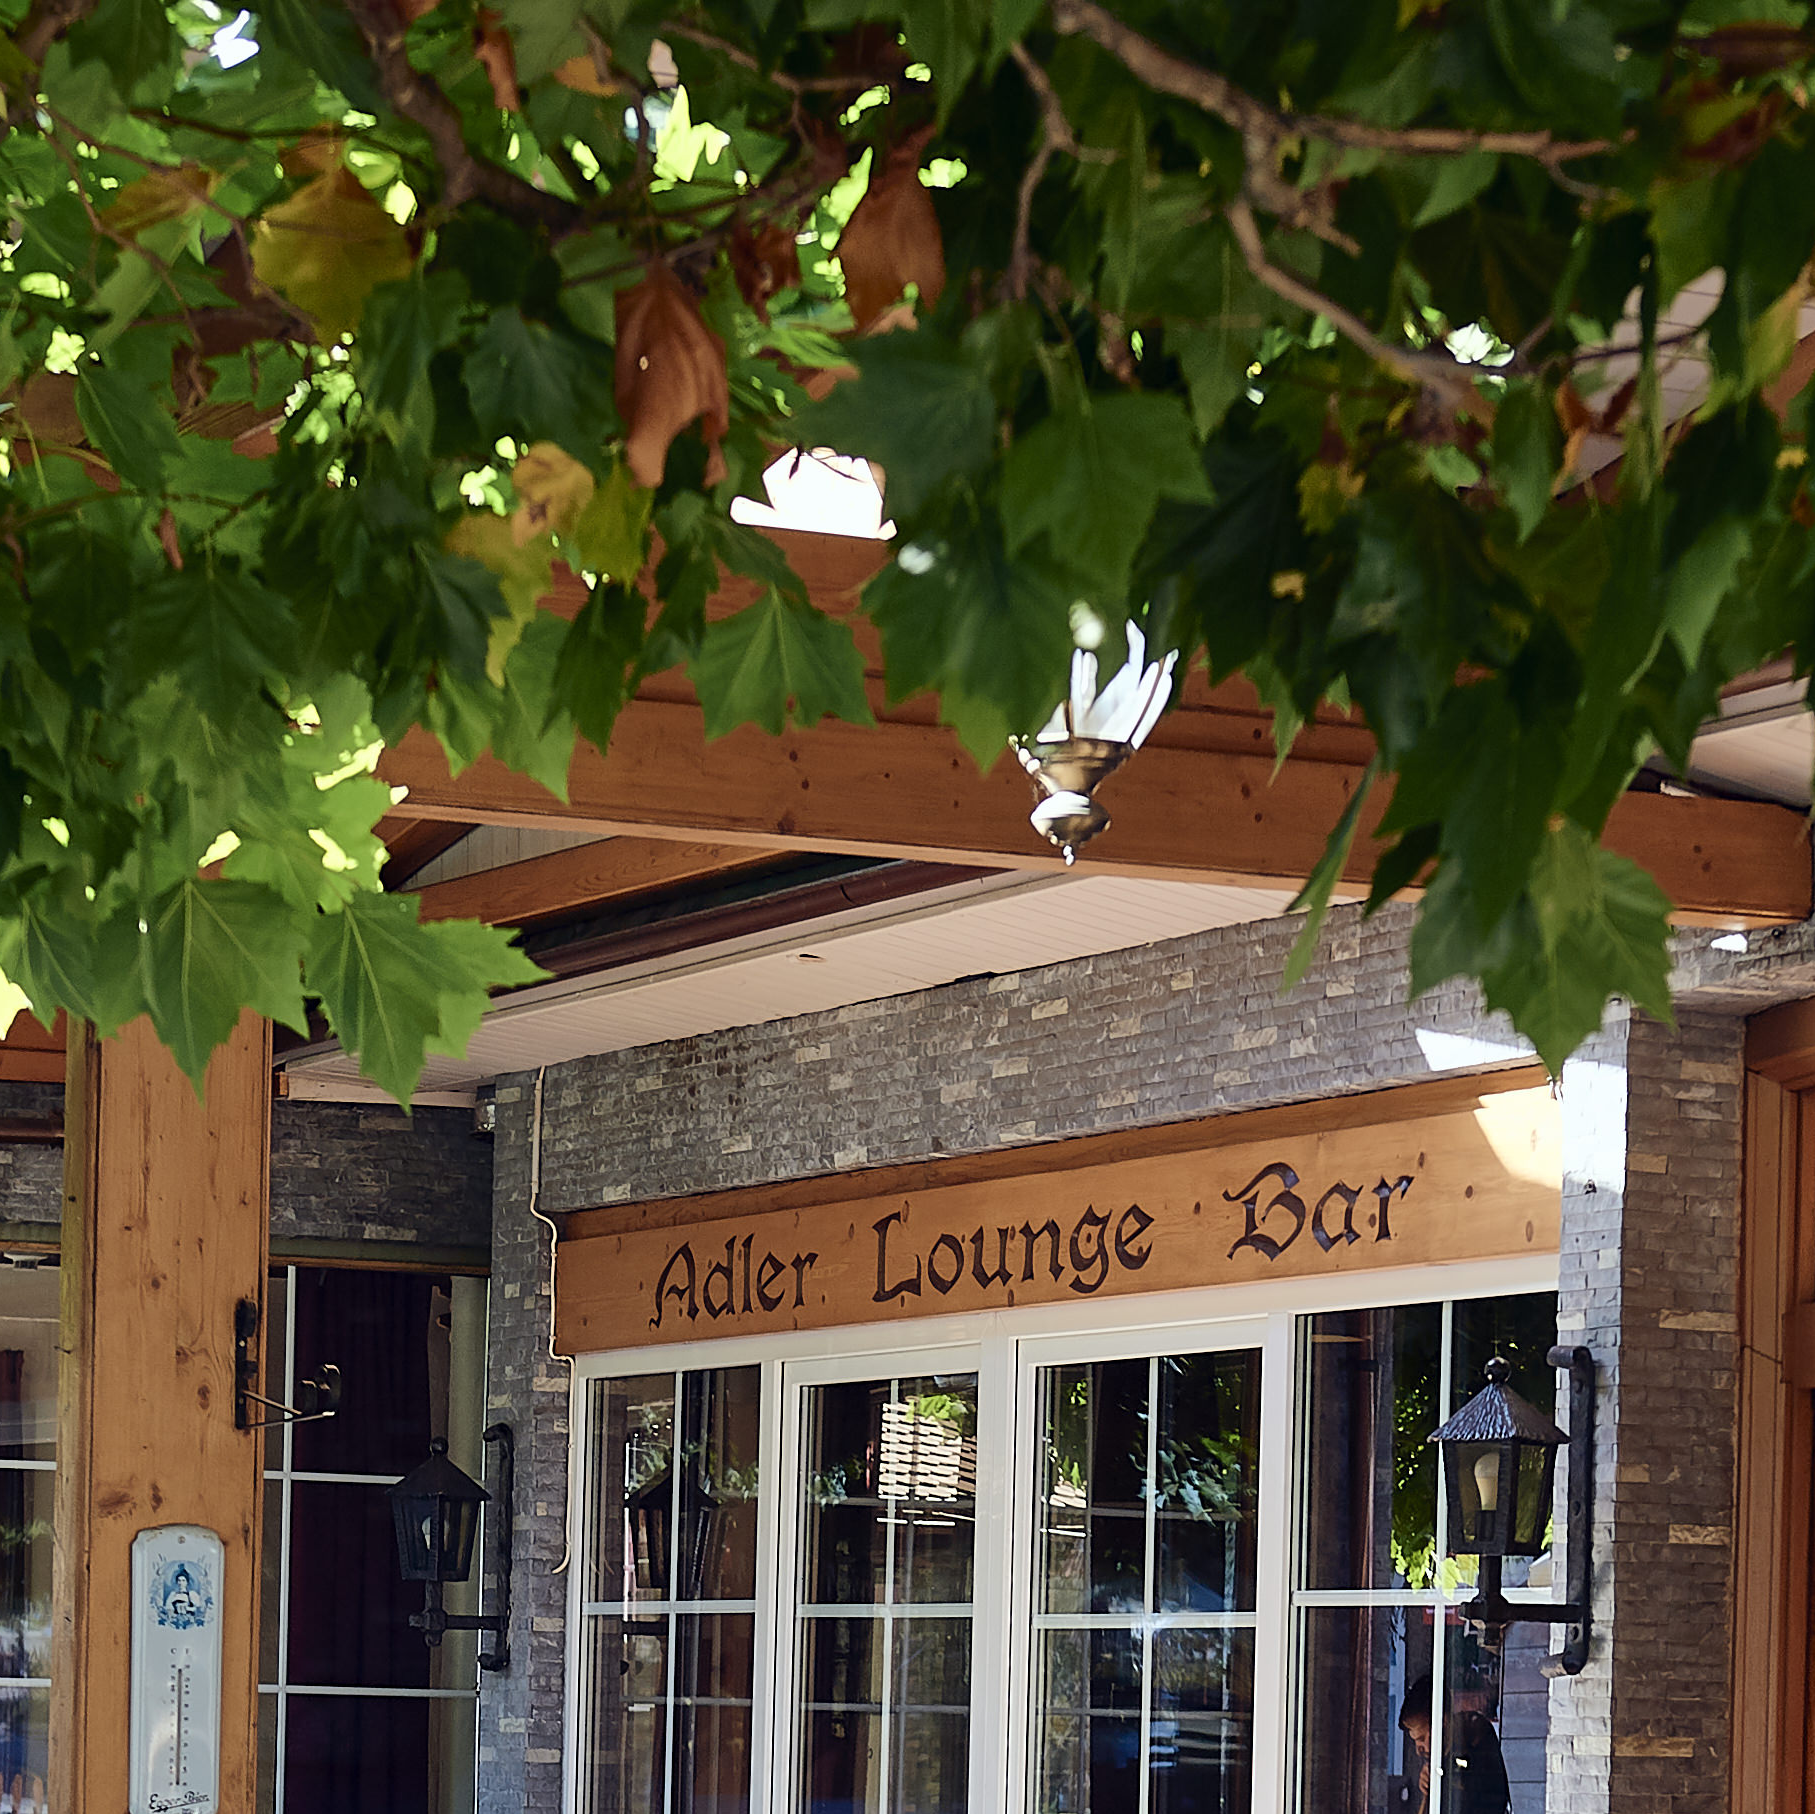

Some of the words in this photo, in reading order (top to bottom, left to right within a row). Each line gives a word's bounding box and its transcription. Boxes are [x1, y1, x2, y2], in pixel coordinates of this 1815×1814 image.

[648, 1232, 819, 1331] Adler
[871, 1203, 1155, 1303] Lounge
[1222, 1161, 1415, 1262] Bar
